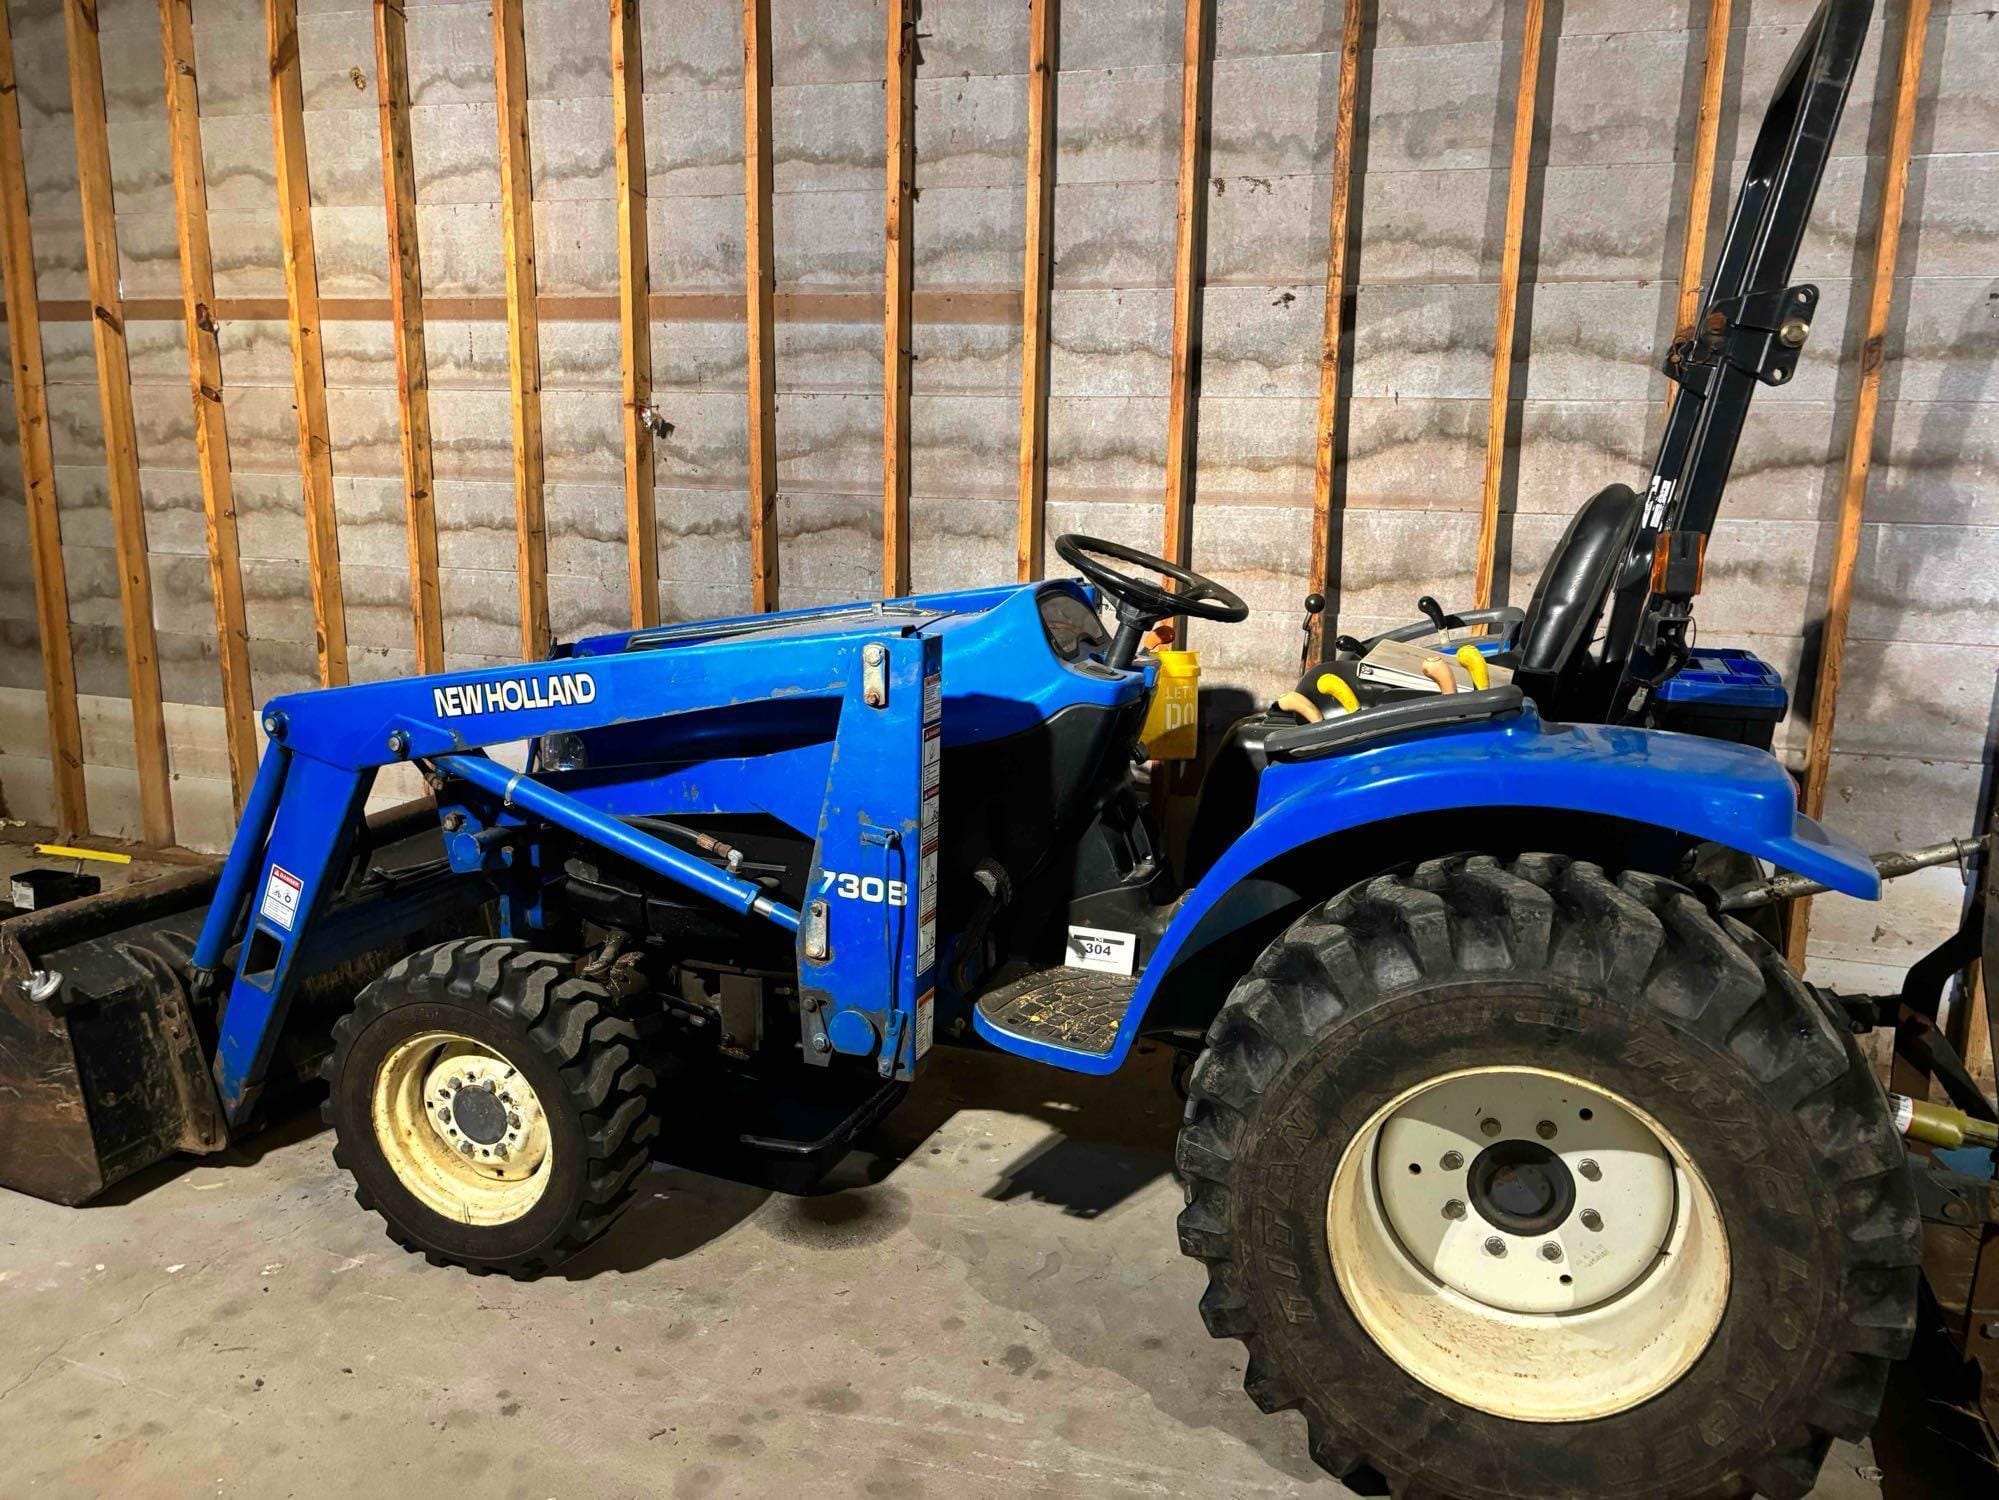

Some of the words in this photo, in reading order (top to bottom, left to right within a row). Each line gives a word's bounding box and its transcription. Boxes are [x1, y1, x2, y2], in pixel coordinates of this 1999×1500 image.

[433, 683, 484, 718] NEW
[485, 672, 597, 713] HOLLAND
[1085, 942, 1112, 956] 304
[1260, 1101, 1318, 1325] TITAN
